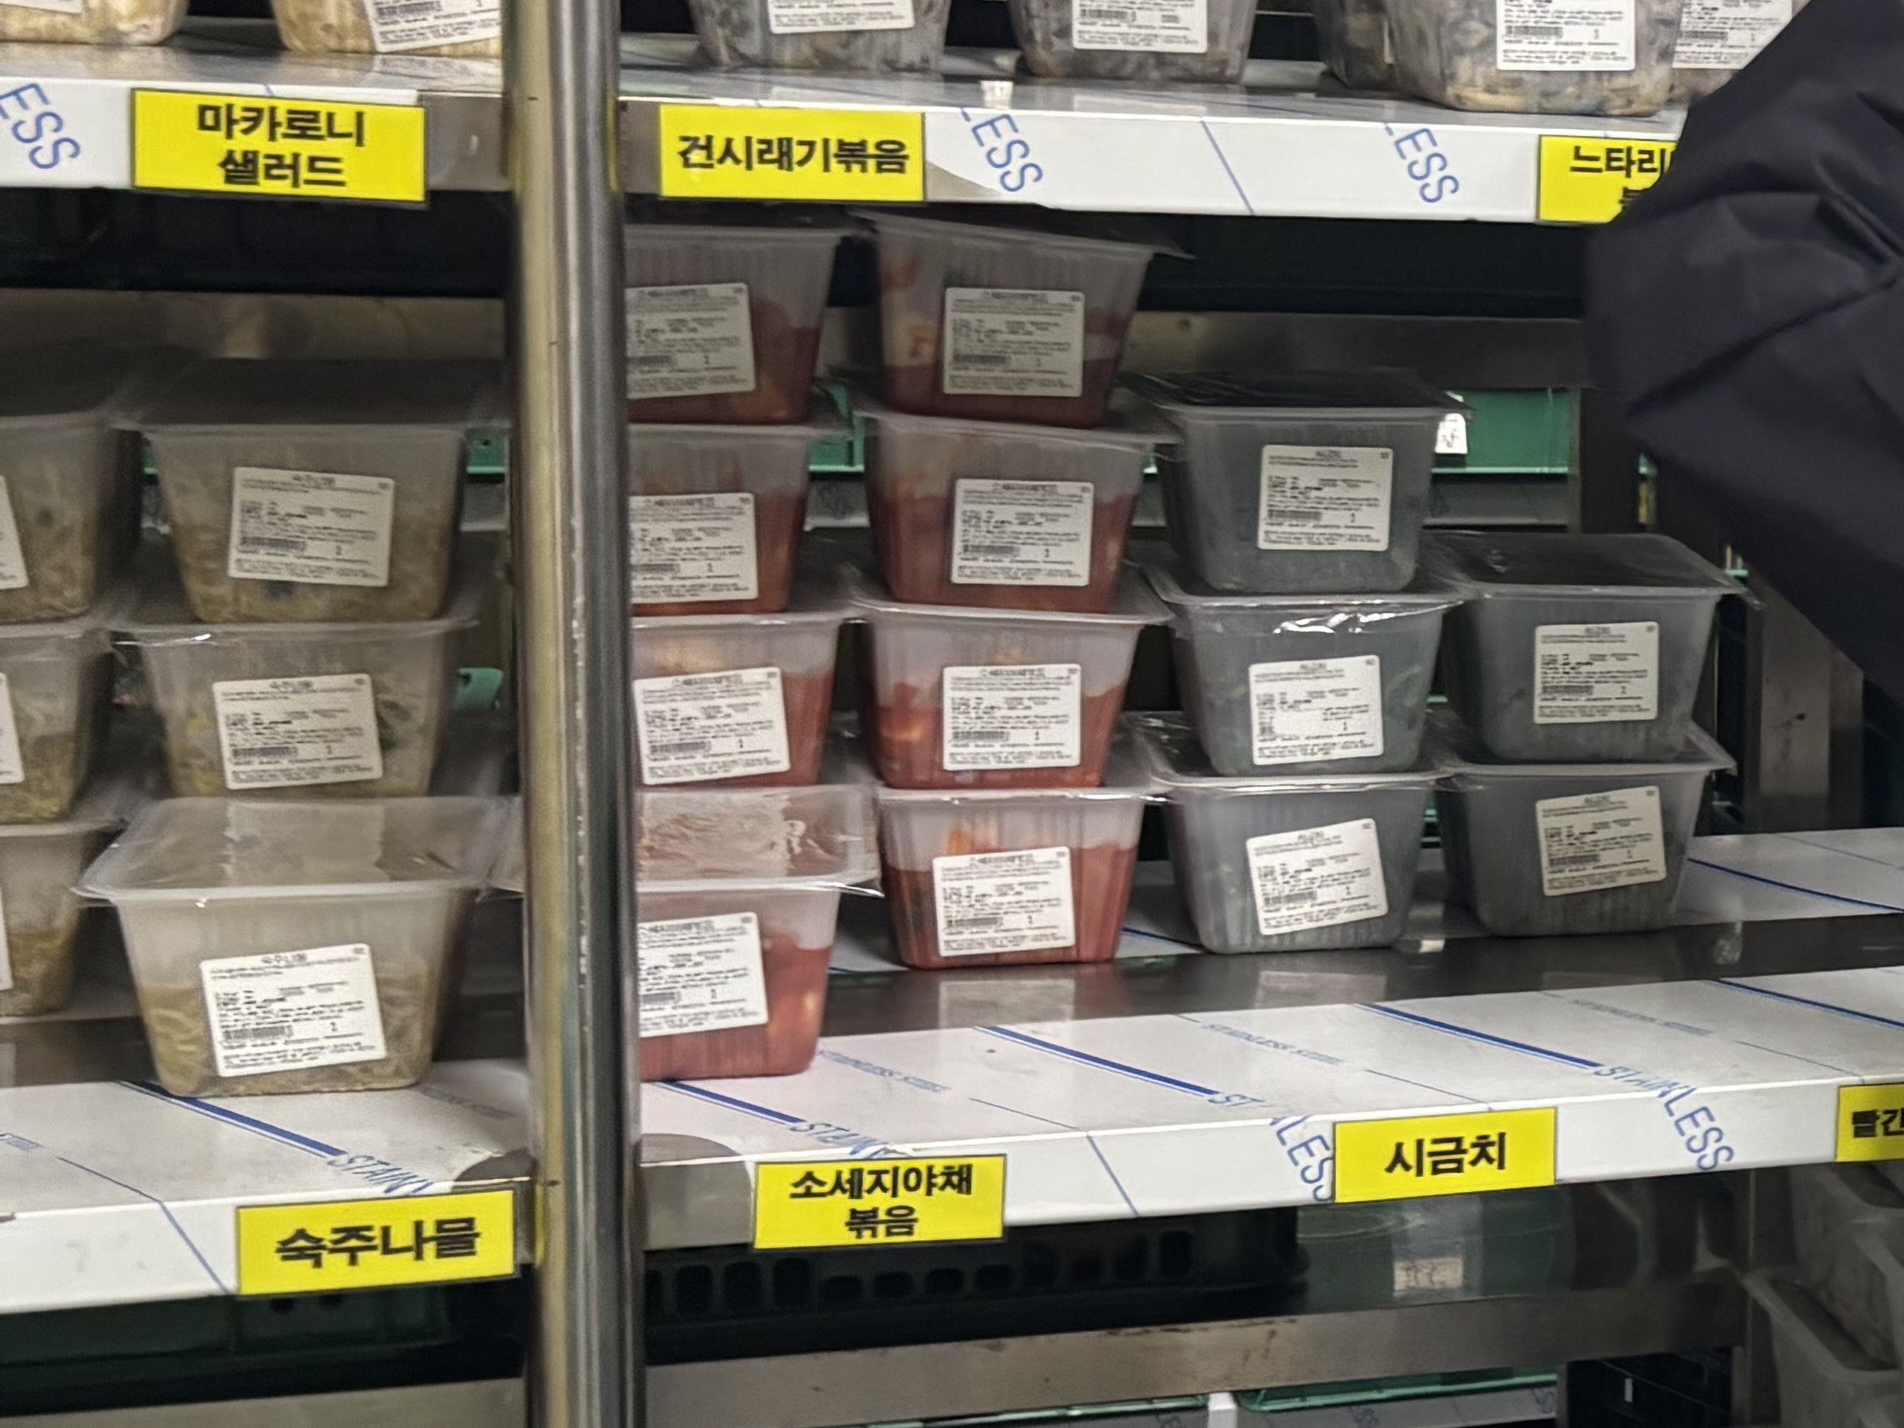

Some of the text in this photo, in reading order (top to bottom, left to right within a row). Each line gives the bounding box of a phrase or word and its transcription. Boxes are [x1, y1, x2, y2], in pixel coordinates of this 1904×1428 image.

[196, 104, 366, 147] 마카로니
[217, 149, 347, 188] 샐러드
[678, 134, 909, 174] 건시래기볶음
[959, 108, 1043, 193] ESS
[1382, 122, 1458, 204] ESS
[1570, 146, 1672, 178] 느타리
[1593, 1065, 1735, 1172] STAINLESS
[1384, 1132, 1508, 1178] 시금치
[789, 1164, 974, 1200] 소세지야채
[275, 1216, 480, 1267] 숙주나물
[844, 1204, 919, 1238] 볶음
